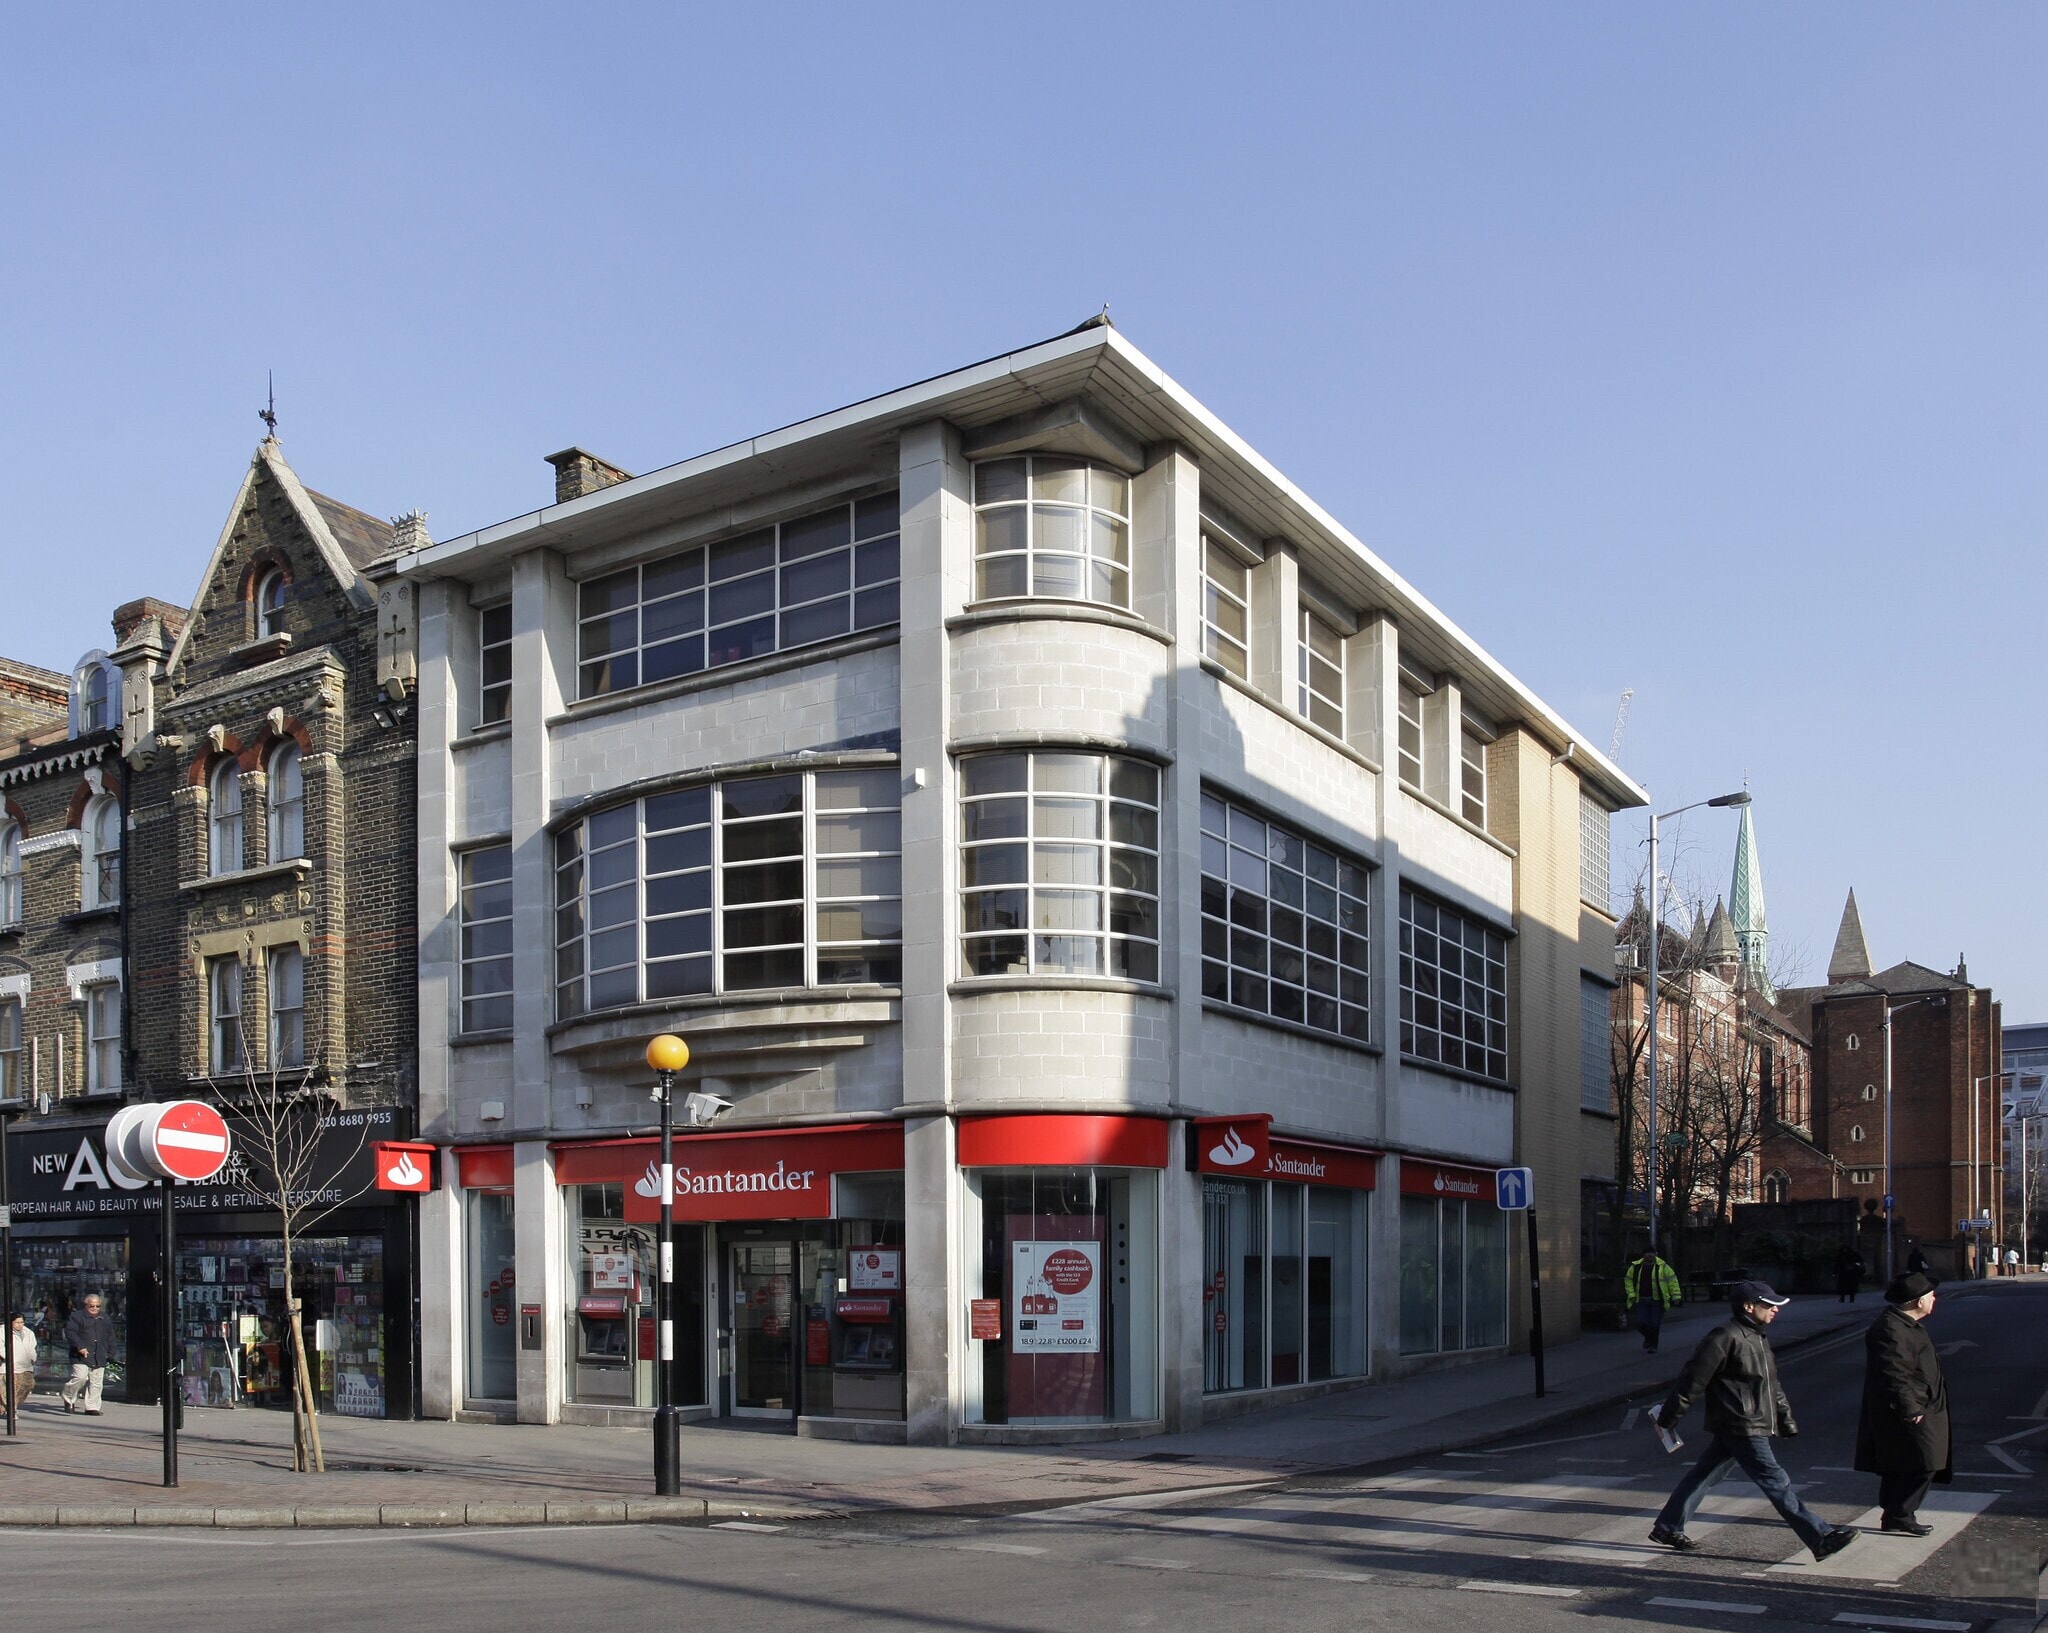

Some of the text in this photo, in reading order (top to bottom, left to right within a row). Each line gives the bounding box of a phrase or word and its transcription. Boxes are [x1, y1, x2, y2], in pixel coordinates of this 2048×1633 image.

[319, 1112, 391, 1128] 020 8680 9955
[33, 1153, 69, 1174] NEW
[1274, 1152, 1326, 1177] Santander
[675, 1160, 815, 1195] Santander
[1444, 1174, 1480, 1194] Santander
[8, 1202, 48, 1215] ROPEAN
[50, 1201, 72, 1213] HAIR
[75, 1199, 96, 1212] AND
[100, 1198, 139, 1211] BEAUTY
[143, 1195, 207, 1210] WHESALE
[211, 1195, 220, 1208] &
[224, 1193, 264, 1207] RETAIL
[266, 1189, 342, 1206] SUERSTORE
[592, 1301, 617, 1309] Santander
[852, 1303, 882, 1311] Santander
